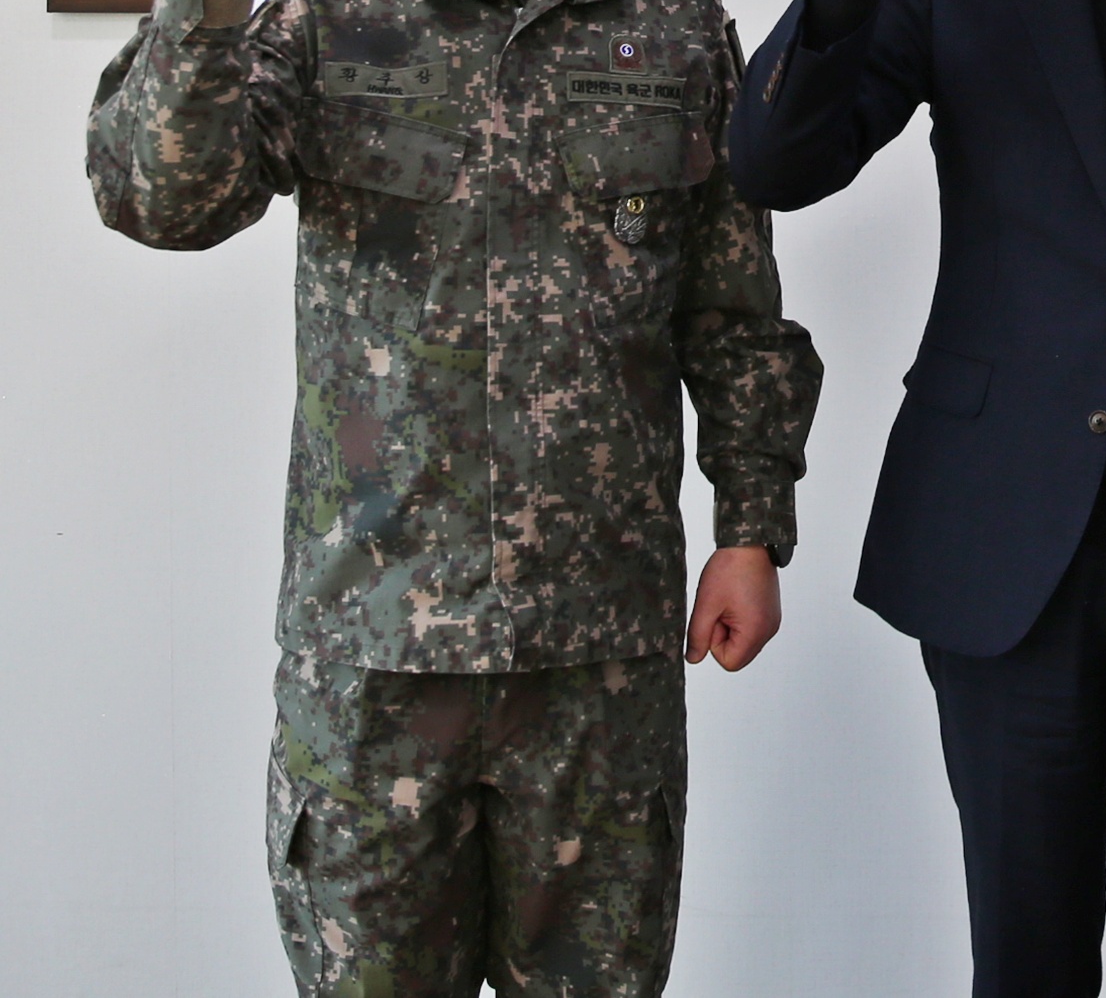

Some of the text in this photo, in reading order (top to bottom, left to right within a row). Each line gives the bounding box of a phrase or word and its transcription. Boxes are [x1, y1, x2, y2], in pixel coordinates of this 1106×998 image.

[571, 79, 682, 100] 대한민국 육군 ROKA
